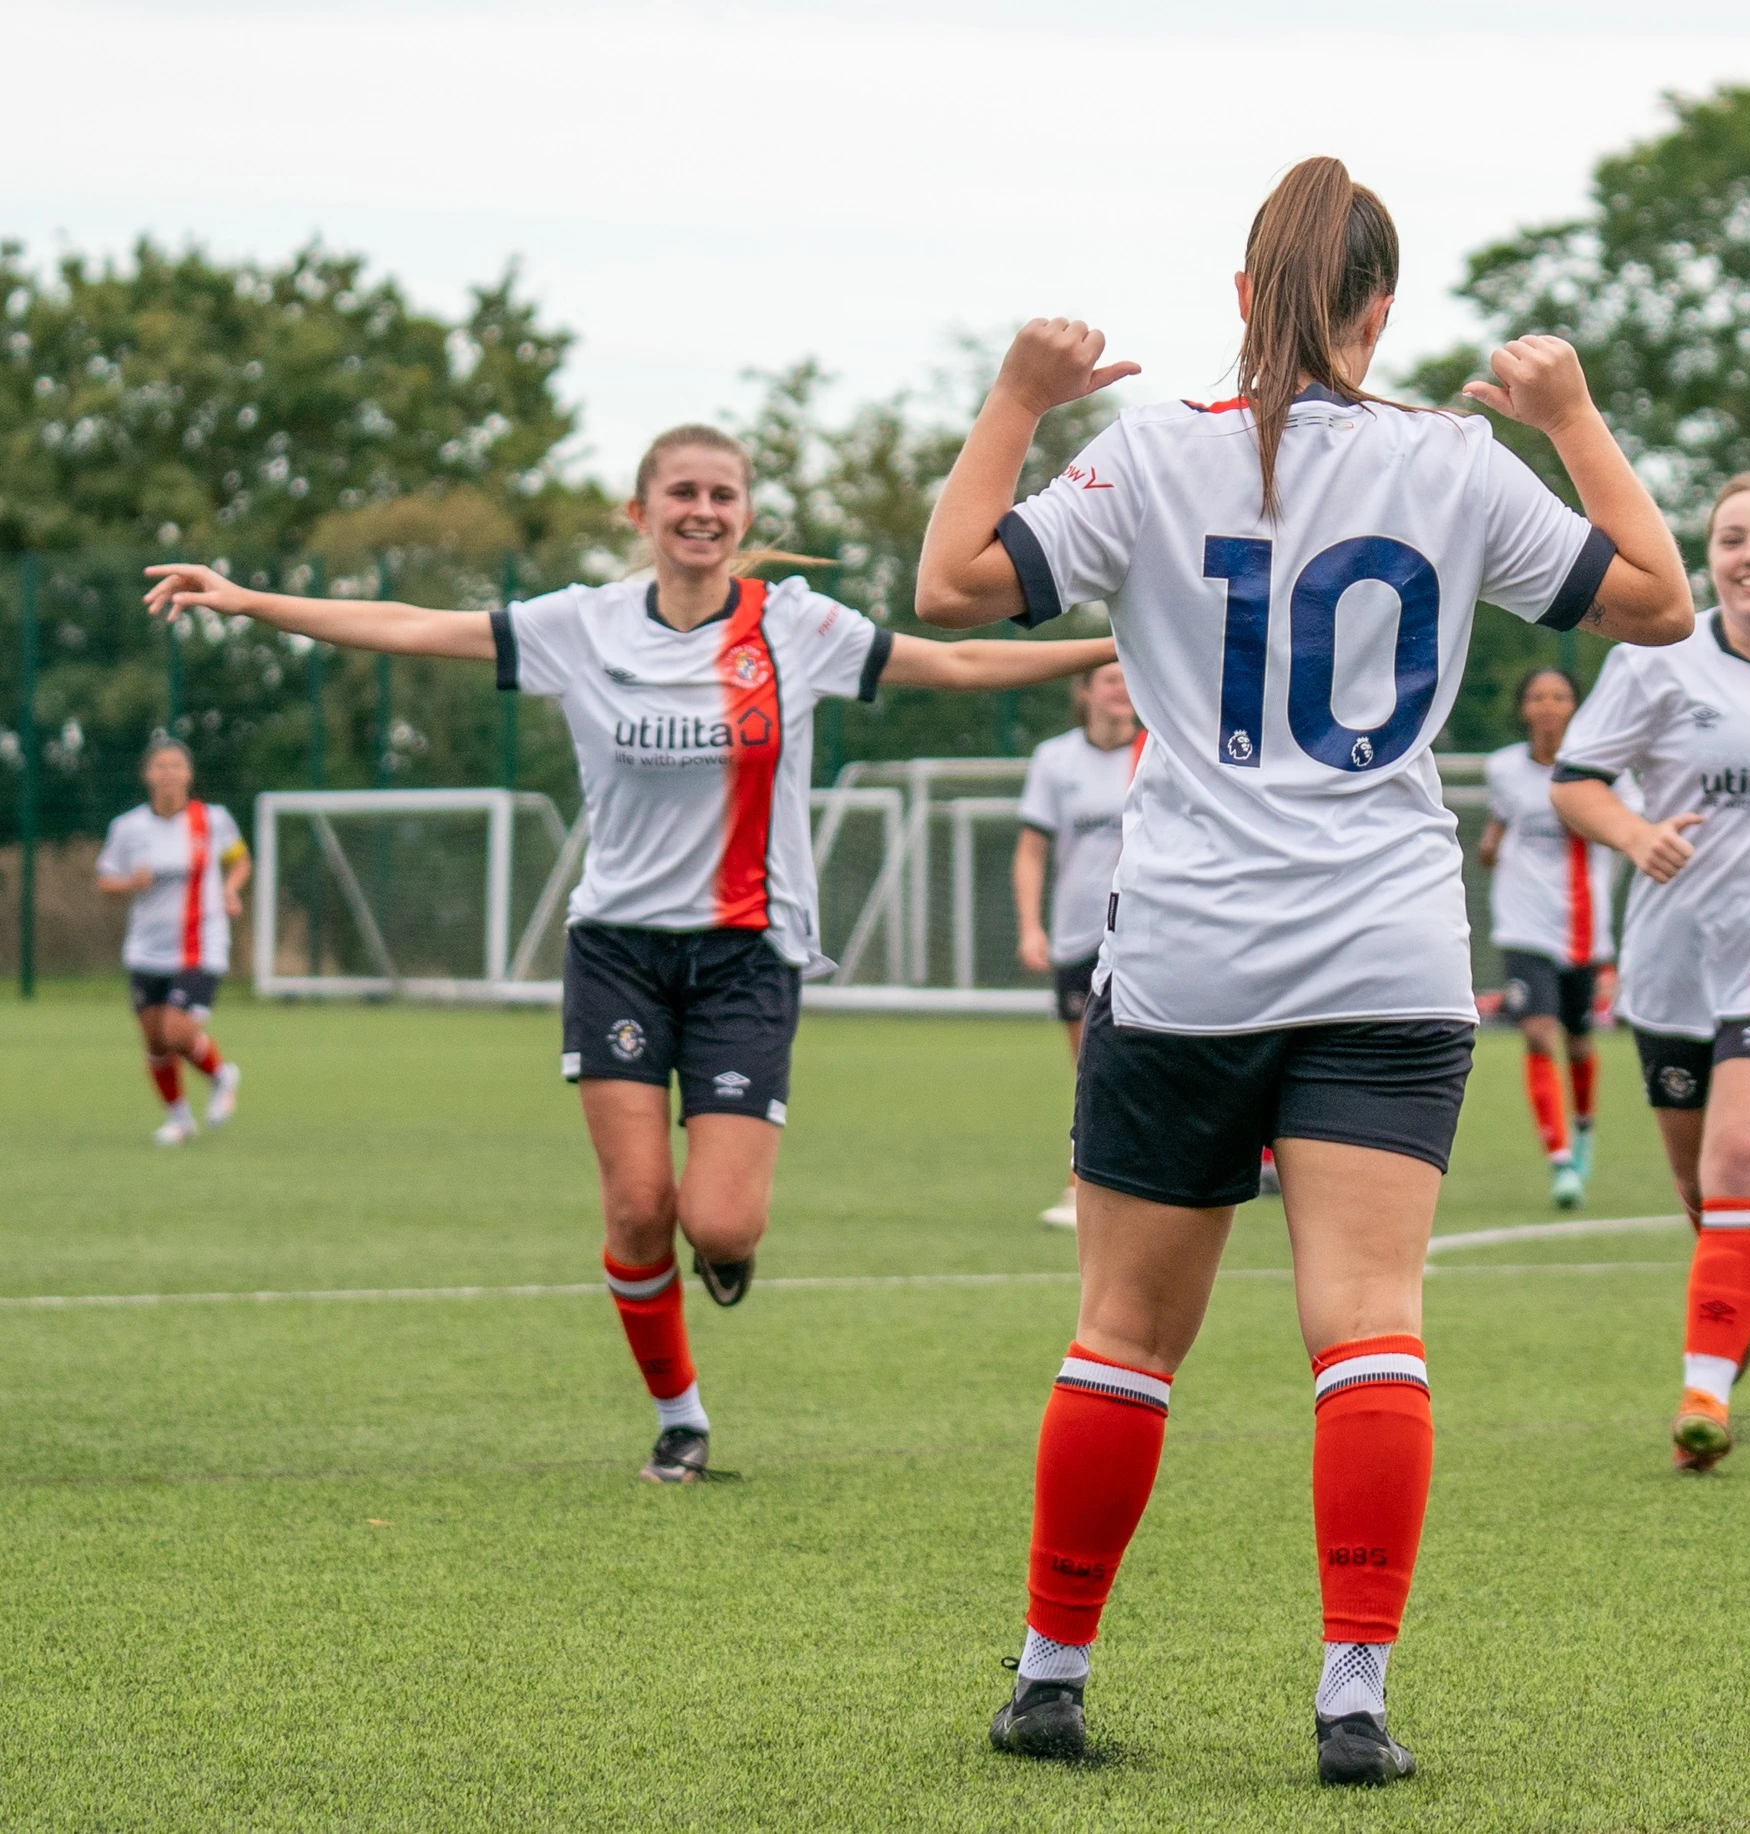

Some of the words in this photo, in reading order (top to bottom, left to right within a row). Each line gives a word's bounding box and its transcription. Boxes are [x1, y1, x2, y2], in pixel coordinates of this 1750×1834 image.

[1202, 535, 1440, 773] 10
[614, 716, 734, 749] utilita
[615, 751, 635, 766] life
[640, 752, 676, 767] with
[1328, 1546, 1389, 1568] 1885
